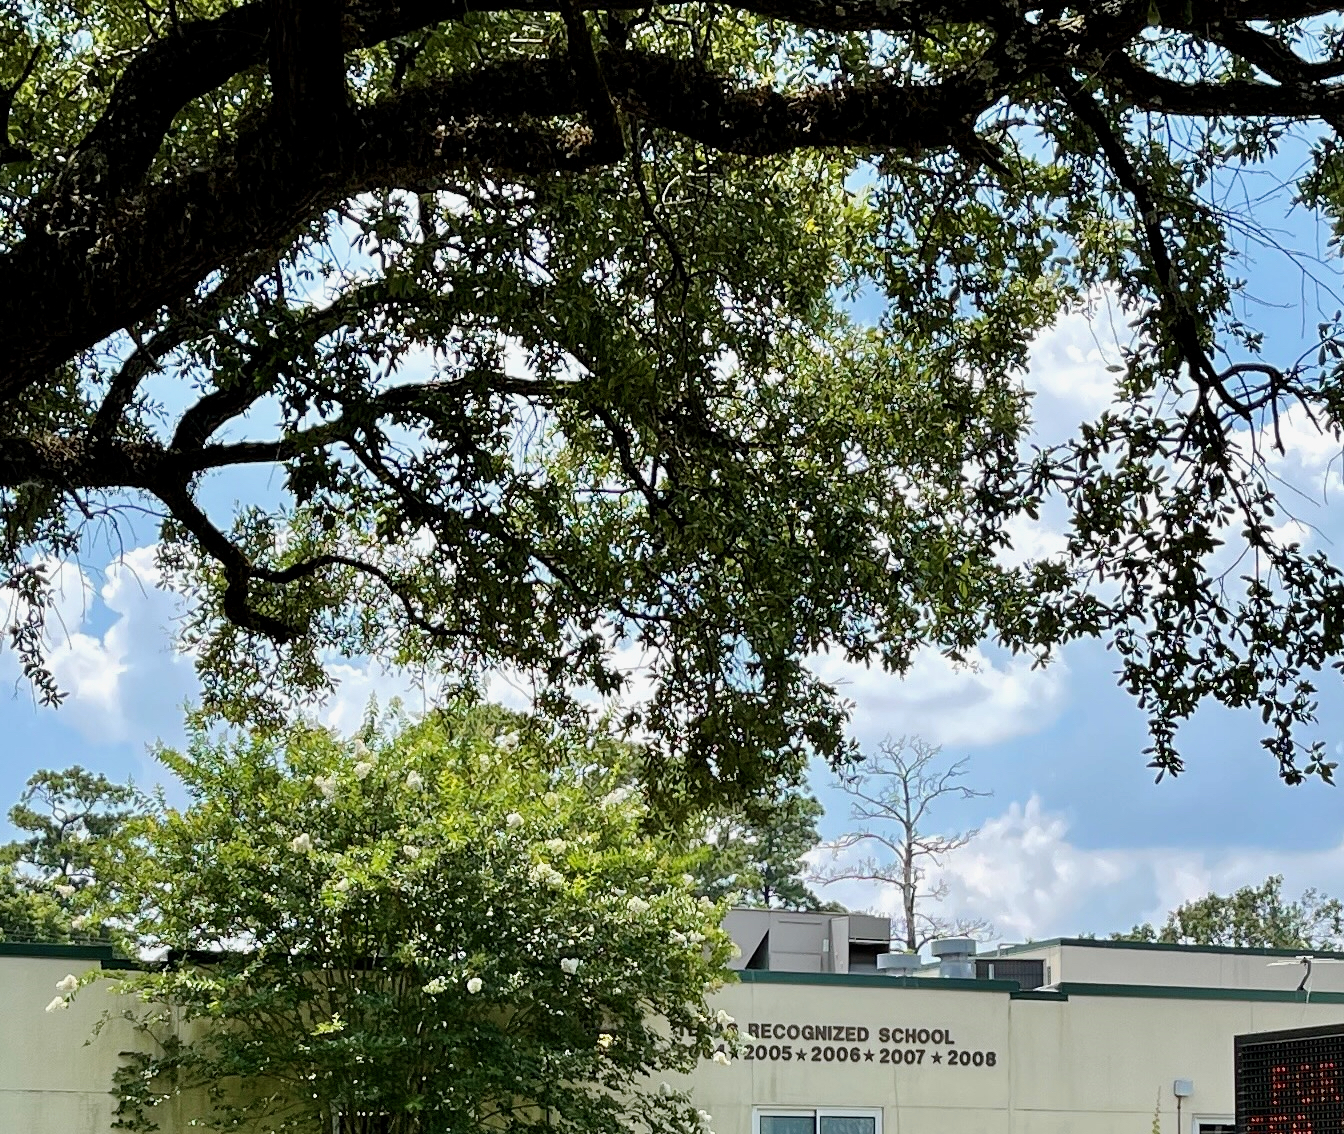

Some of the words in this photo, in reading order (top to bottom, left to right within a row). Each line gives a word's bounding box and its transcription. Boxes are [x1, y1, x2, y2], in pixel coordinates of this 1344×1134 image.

[748, 1023, 870, 1042] RECOGNIZED
[878, 1027, 955, 1045] SCHOOL
[743, 1044, 793, 1061] 2005
[811, 1046, 861, 1063] 2006
[879, 1048, 926, 1065] 2007
[947, 1049, 997, 1067] 2008
[1272, 1062, 1340, 1105] POR
